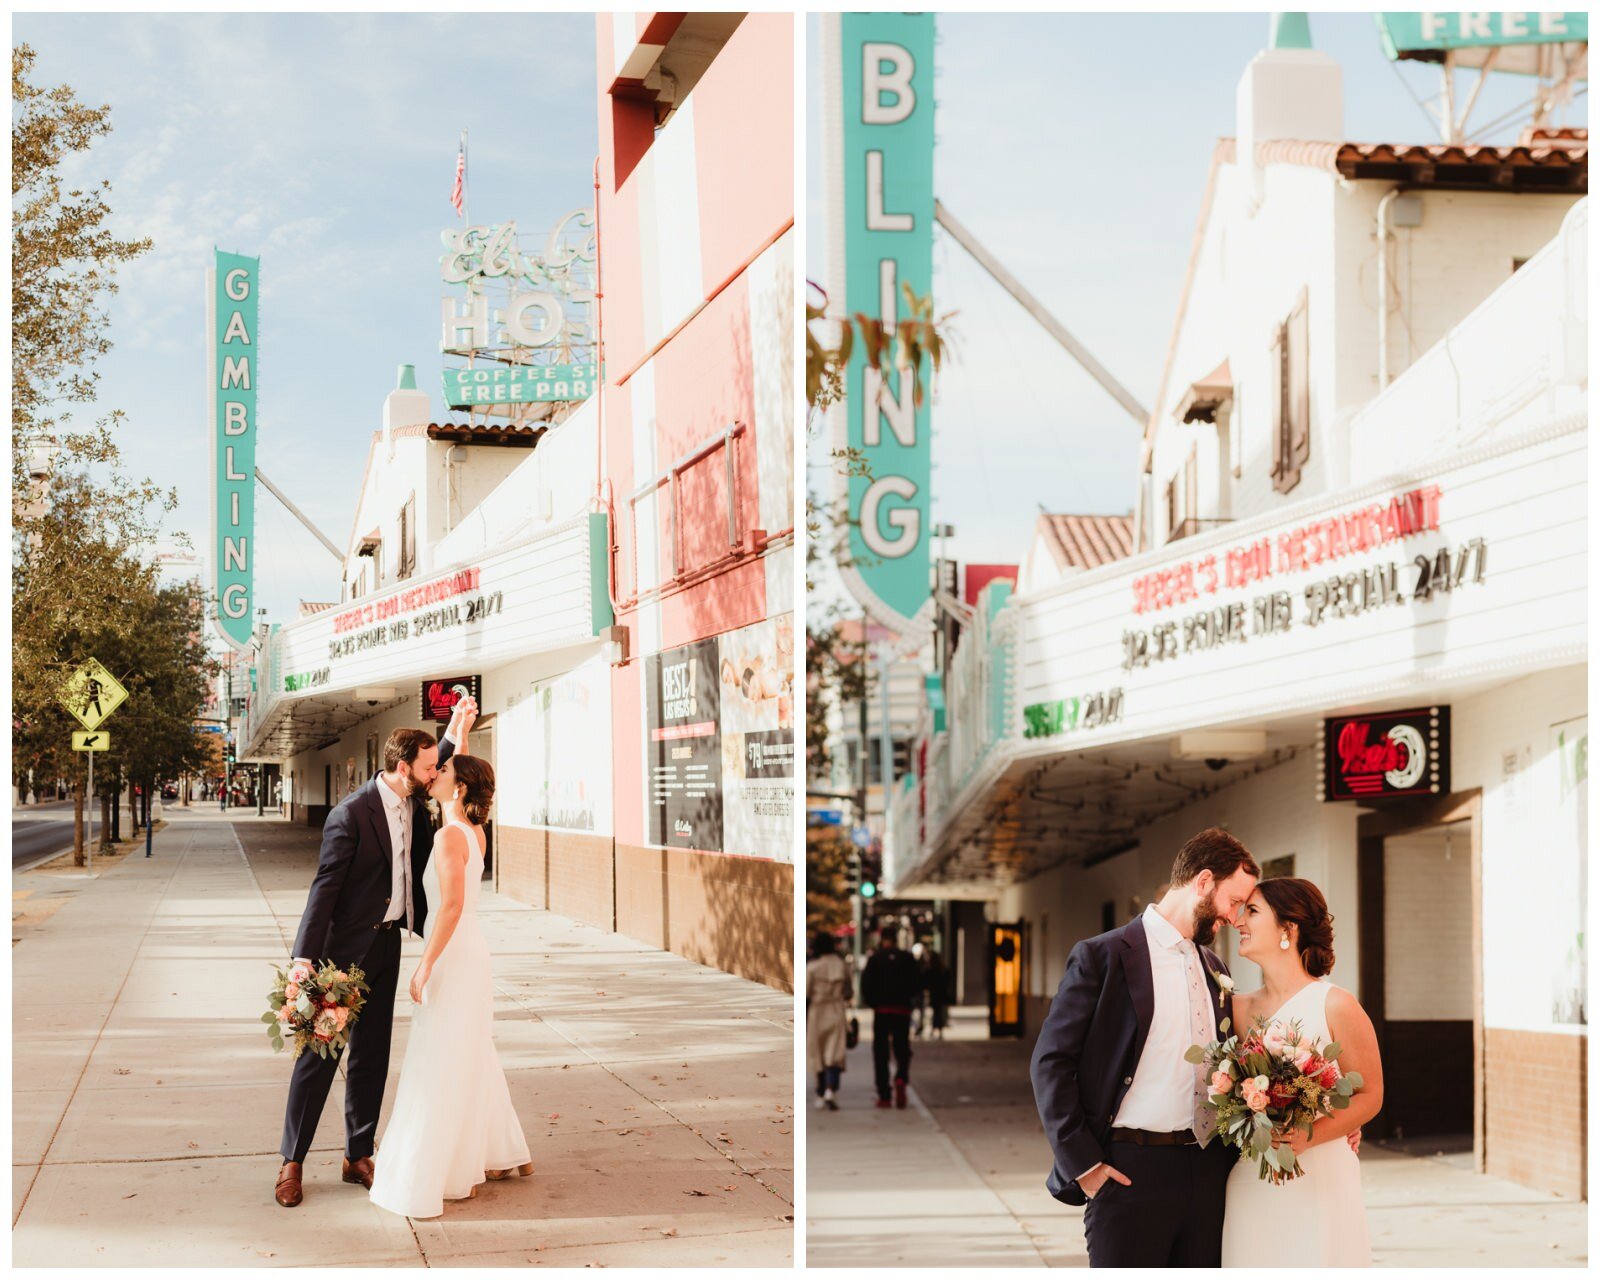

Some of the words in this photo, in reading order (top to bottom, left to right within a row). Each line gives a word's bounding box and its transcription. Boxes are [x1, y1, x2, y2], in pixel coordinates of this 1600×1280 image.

[1419, 12, 1568, 40] FREE
[440, 219, 517, 283] El
[860, 12, 921, 559] BLING
[457, 368, 557, 383] COFFEE
[460, 383, 522, 401] FREE
[220, 267, 252, 620] GAMBLING
[1278, 484, 1443, 574] RESTAURANT
[401, 567, 481, 613] RESTAURANT
[1303, 560, 1405, 627] SPECIAL
[1414, 536, 1490, 601] 24/7
[413, 604, 463, 637] SPECIAL
[466, 590, 504, 624] 24/7
[663, 662, 687, 701] BEST
